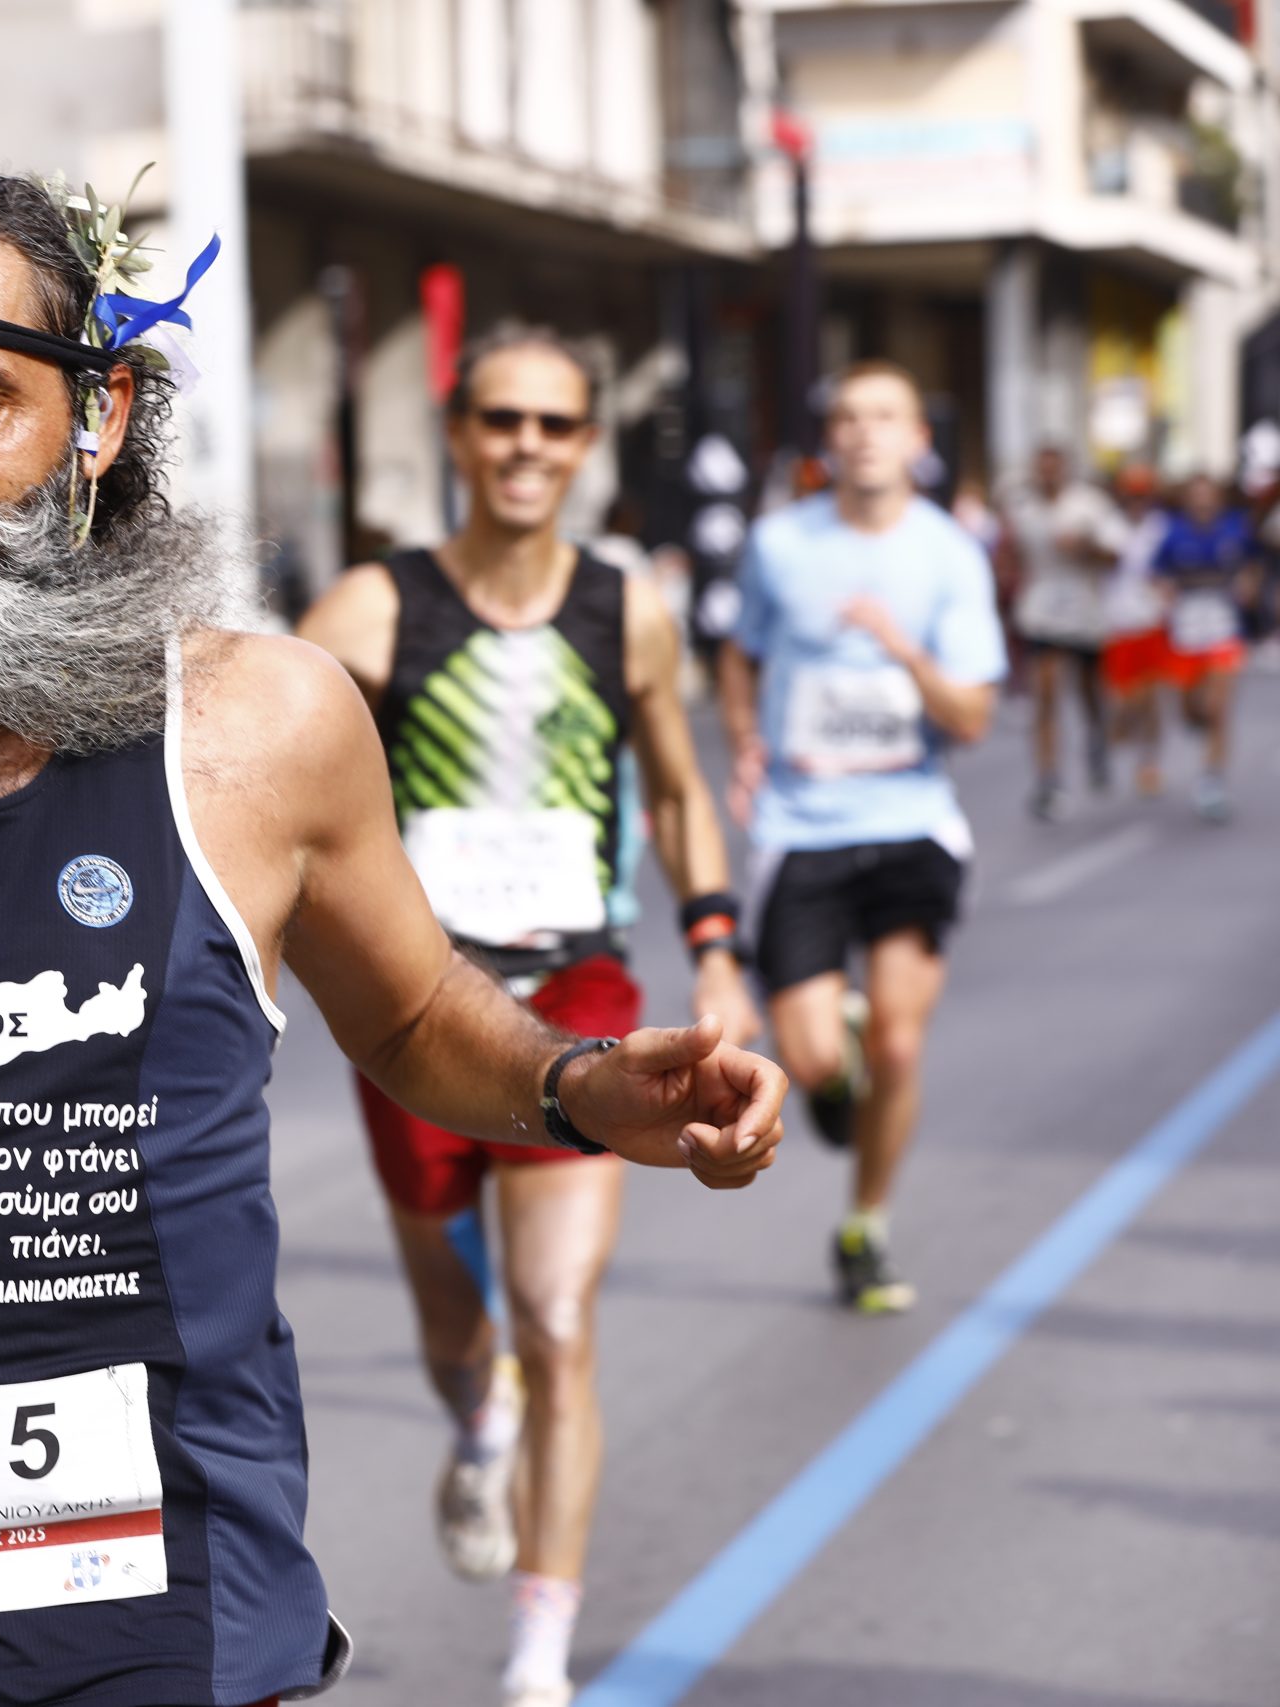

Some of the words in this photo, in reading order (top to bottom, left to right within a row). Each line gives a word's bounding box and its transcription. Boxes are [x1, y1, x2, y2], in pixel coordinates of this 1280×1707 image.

[63, 1094, 159, 1134] μπορεί
[42, 1140, 139, 1179] φτάνει
[88, 1187, 138, 1215] σου
[9, 1226, 107, 1259] πιάνει.
[7, 1526, 47, 1545] 2025
